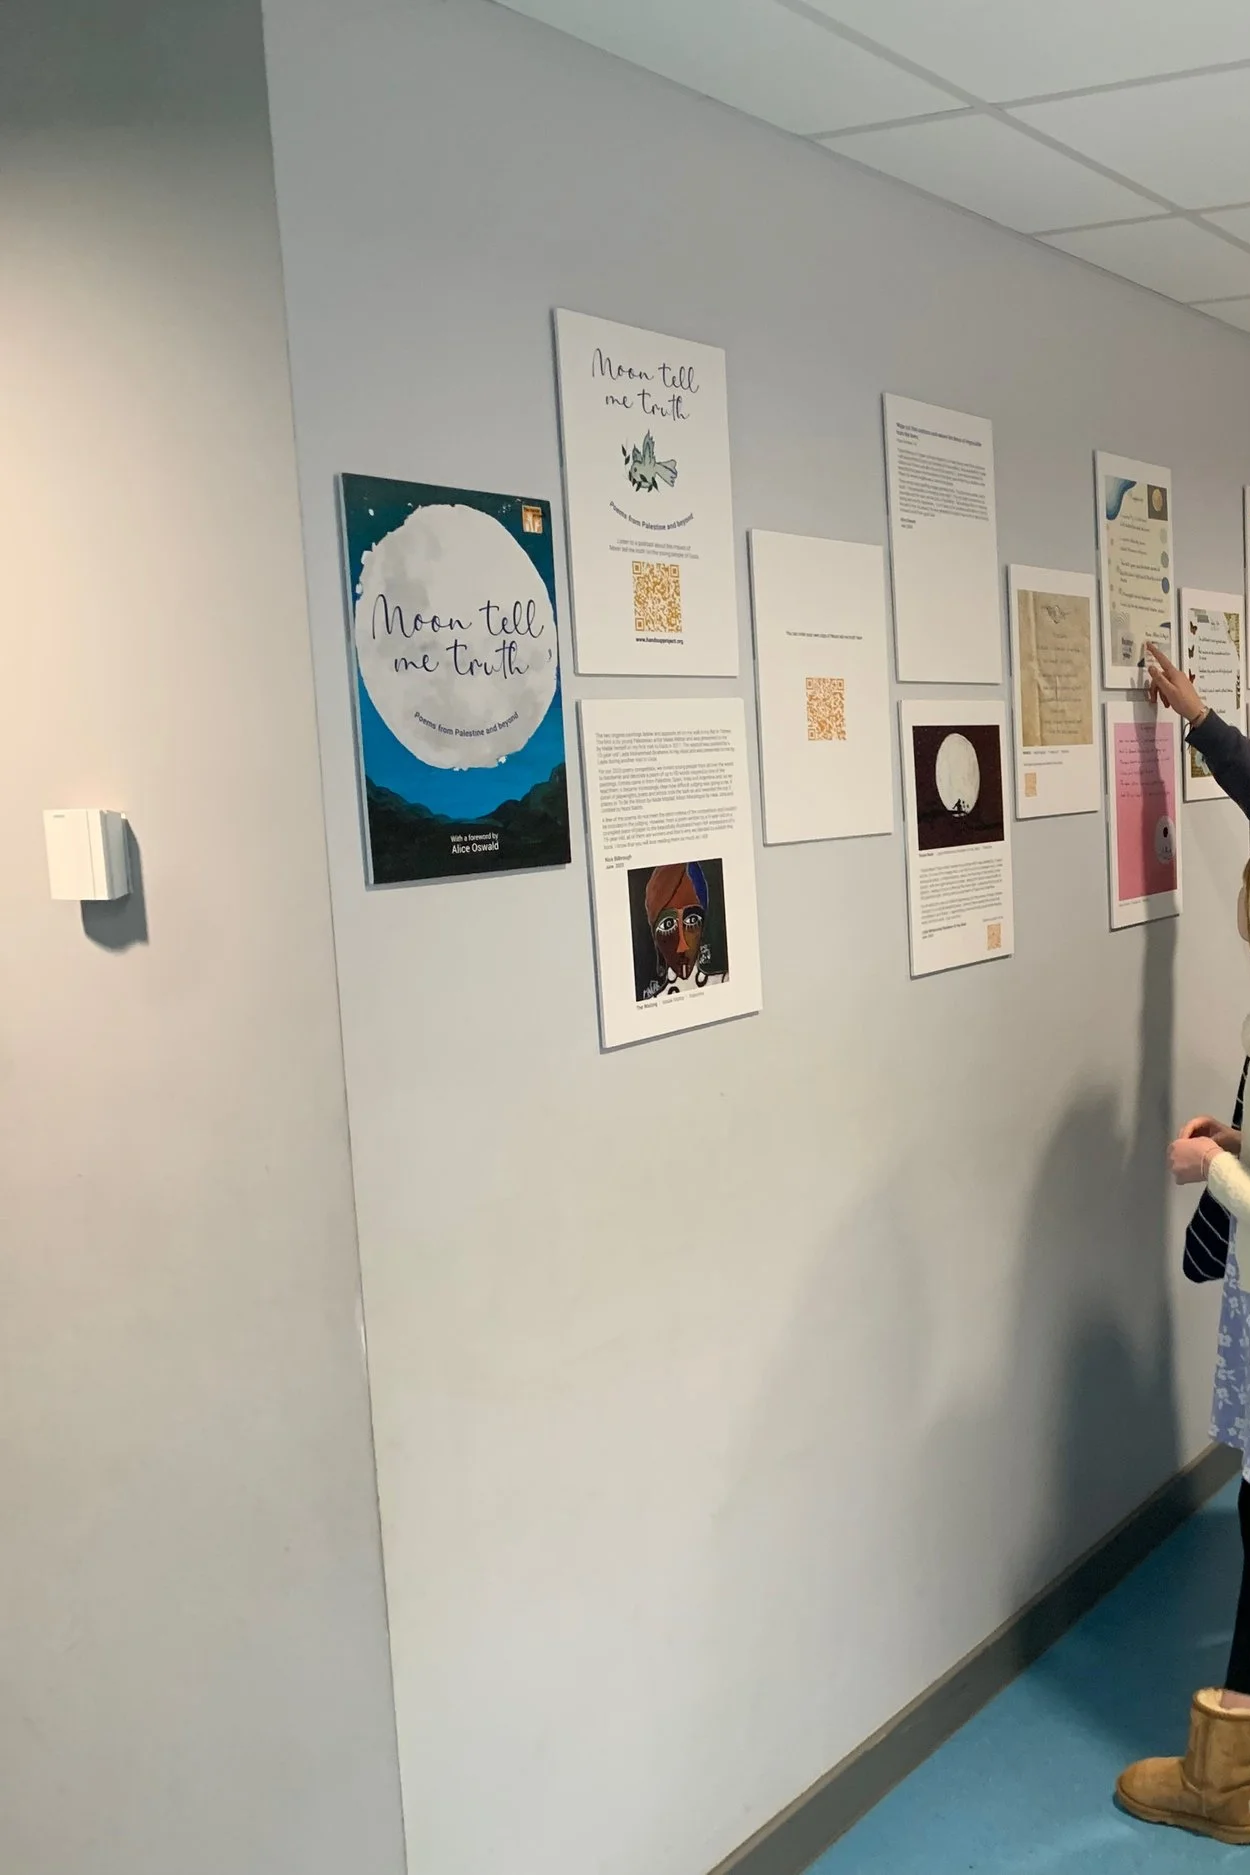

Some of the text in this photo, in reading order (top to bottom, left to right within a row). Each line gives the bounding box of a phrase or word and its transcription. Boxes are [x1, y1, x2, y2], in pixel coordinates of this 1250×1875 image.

[591, 347, 700, 394] Moon tell
[605, 388, 690, 421] me truth
[609, 500, 694, 531] Poems from Palestine and beyond
[372, 593, 545, 640] Moon tell
[394, 638, 530, 680] me truth
[414, 711, 519, 737] Poems from Palestine and beyond
[450, 834, 463, 843] With
[468, 832, 491, 841] foreword
[491, 832, 499, 841] by
[451, 841, 499, 854] Alice Oswald
